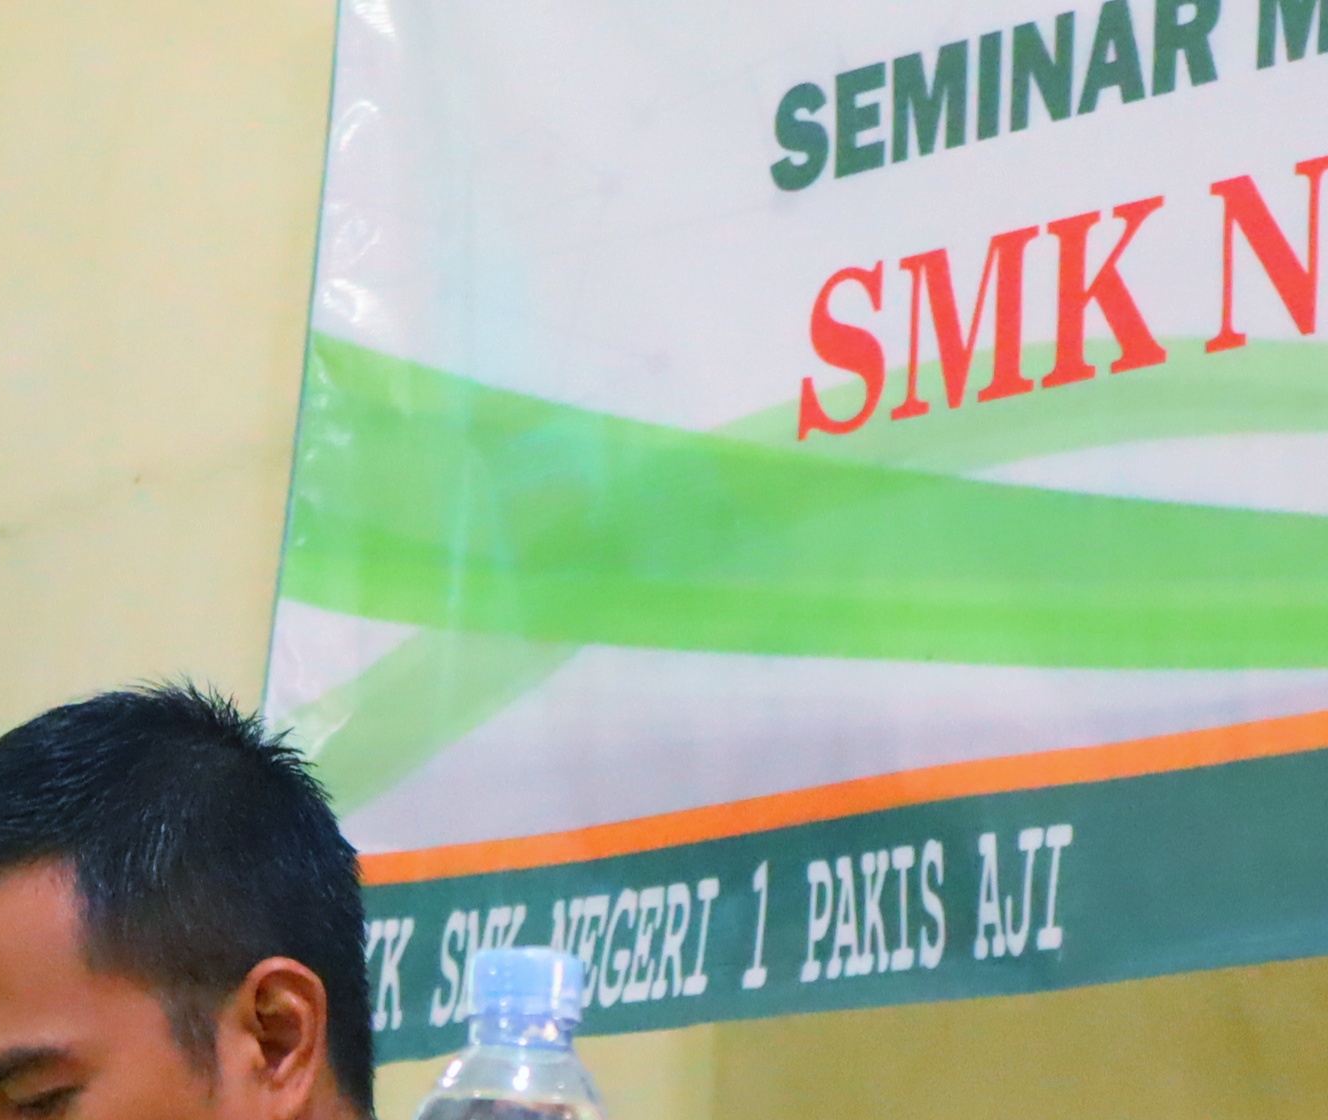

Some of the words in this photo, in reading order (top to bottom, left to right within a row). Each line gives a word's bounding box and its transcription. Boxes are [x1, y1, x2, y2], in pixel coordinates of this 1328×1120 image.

[770, 0, 1221, 191] SEMINAR
[797, 195, 1167, 441] SMK
[741, 860, 770, 990] 1
[799, 840, 945, 983] PAKIS
[974, 824, 1074, 962] AJI
